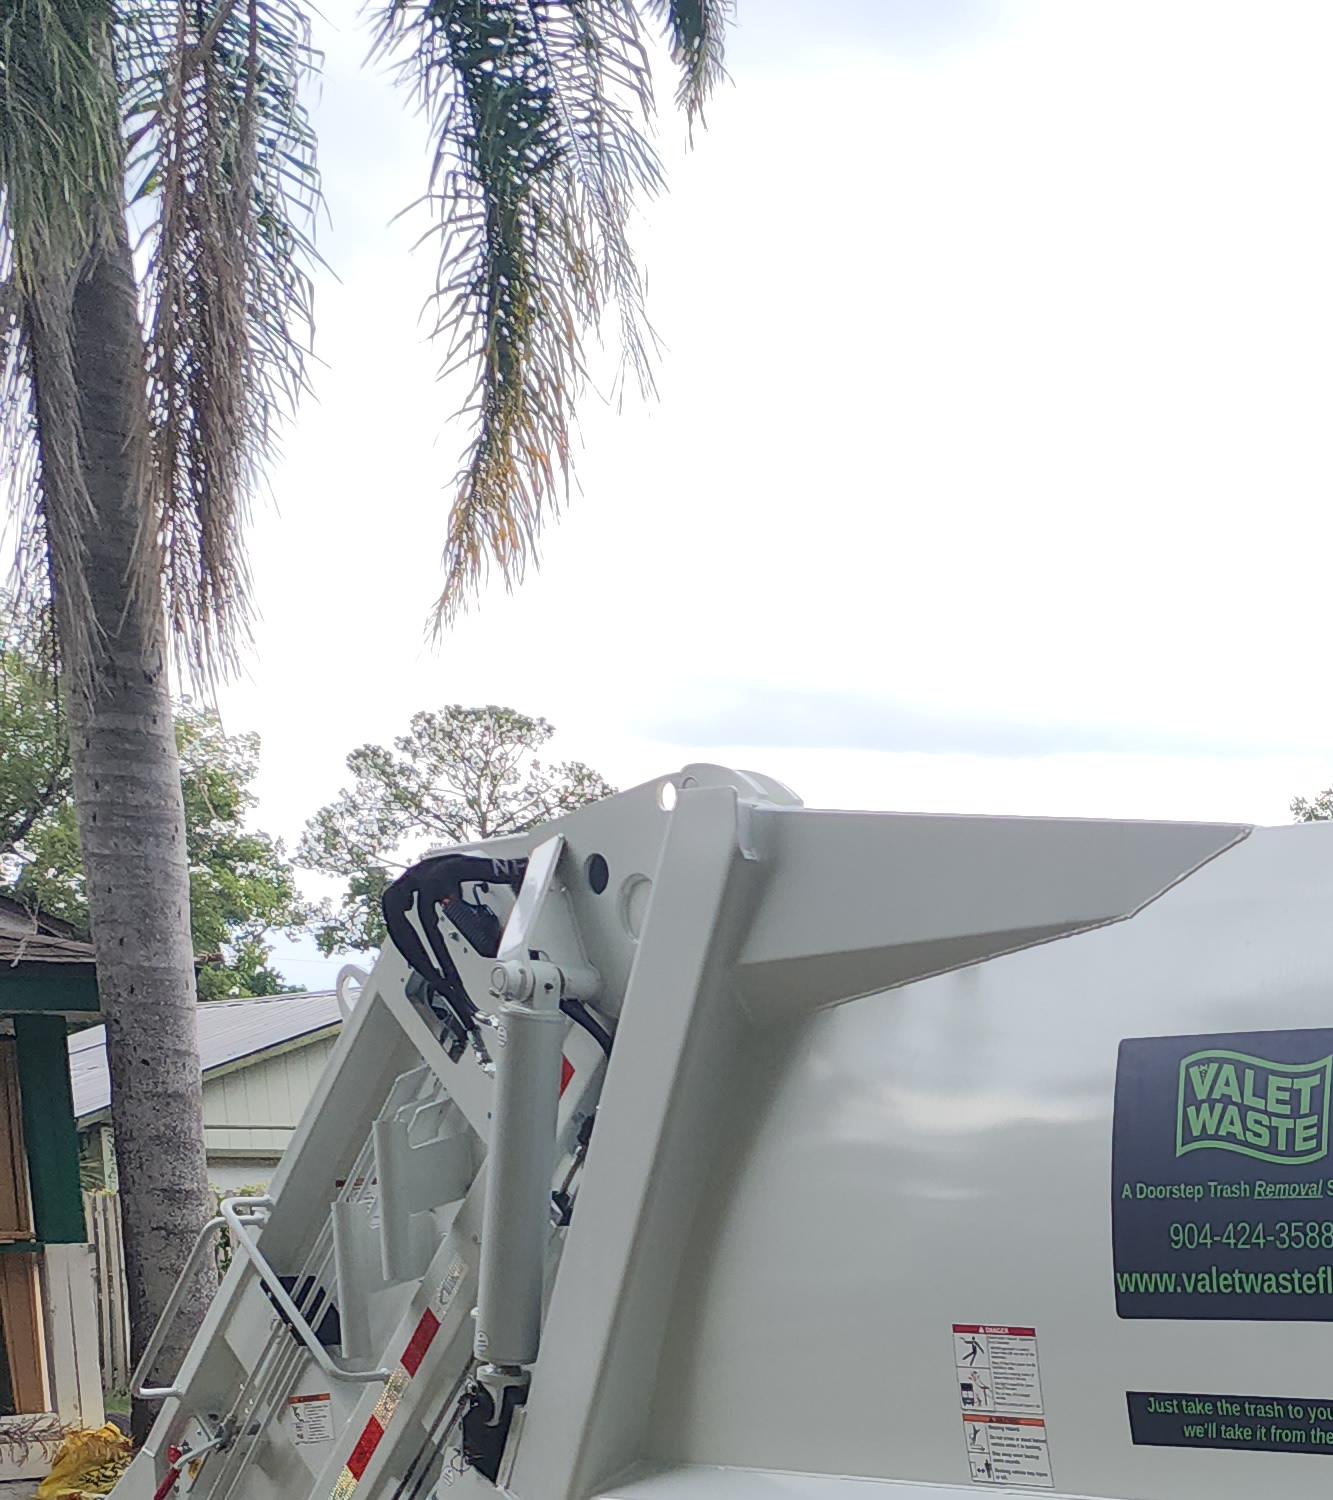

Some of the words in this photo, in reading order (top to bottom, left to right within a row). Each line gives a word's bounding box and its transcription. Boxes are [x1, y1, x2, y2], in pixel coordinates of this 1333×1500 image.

[1189, 1063, 1320, 1114] VALET
[1187, 1103, 1318, 1151] WASTE
[1121, 1183, 1132, 1198] A
[1136, 1183, 1204, 1202] Doorstep
[1208, 1180, 1249, 1198] Trash
[1254, 1179, 1323, 1199] Removal
[1147, 1397, 1179, 1414] Just
[1181, 1398, 1213, 1415] take
[1217, 1399, 1240, 1416] the
[1244, 1401, 1284, 1418] trash
[1288, 1403, 1303, 1419] to
[1183, 1422, 1217, 1439] we'll
[1221, 1423, 1252, 1440] take
[1256, 1424, 1267, 1442] it
[1271, 1425, 1306, 1443] from
